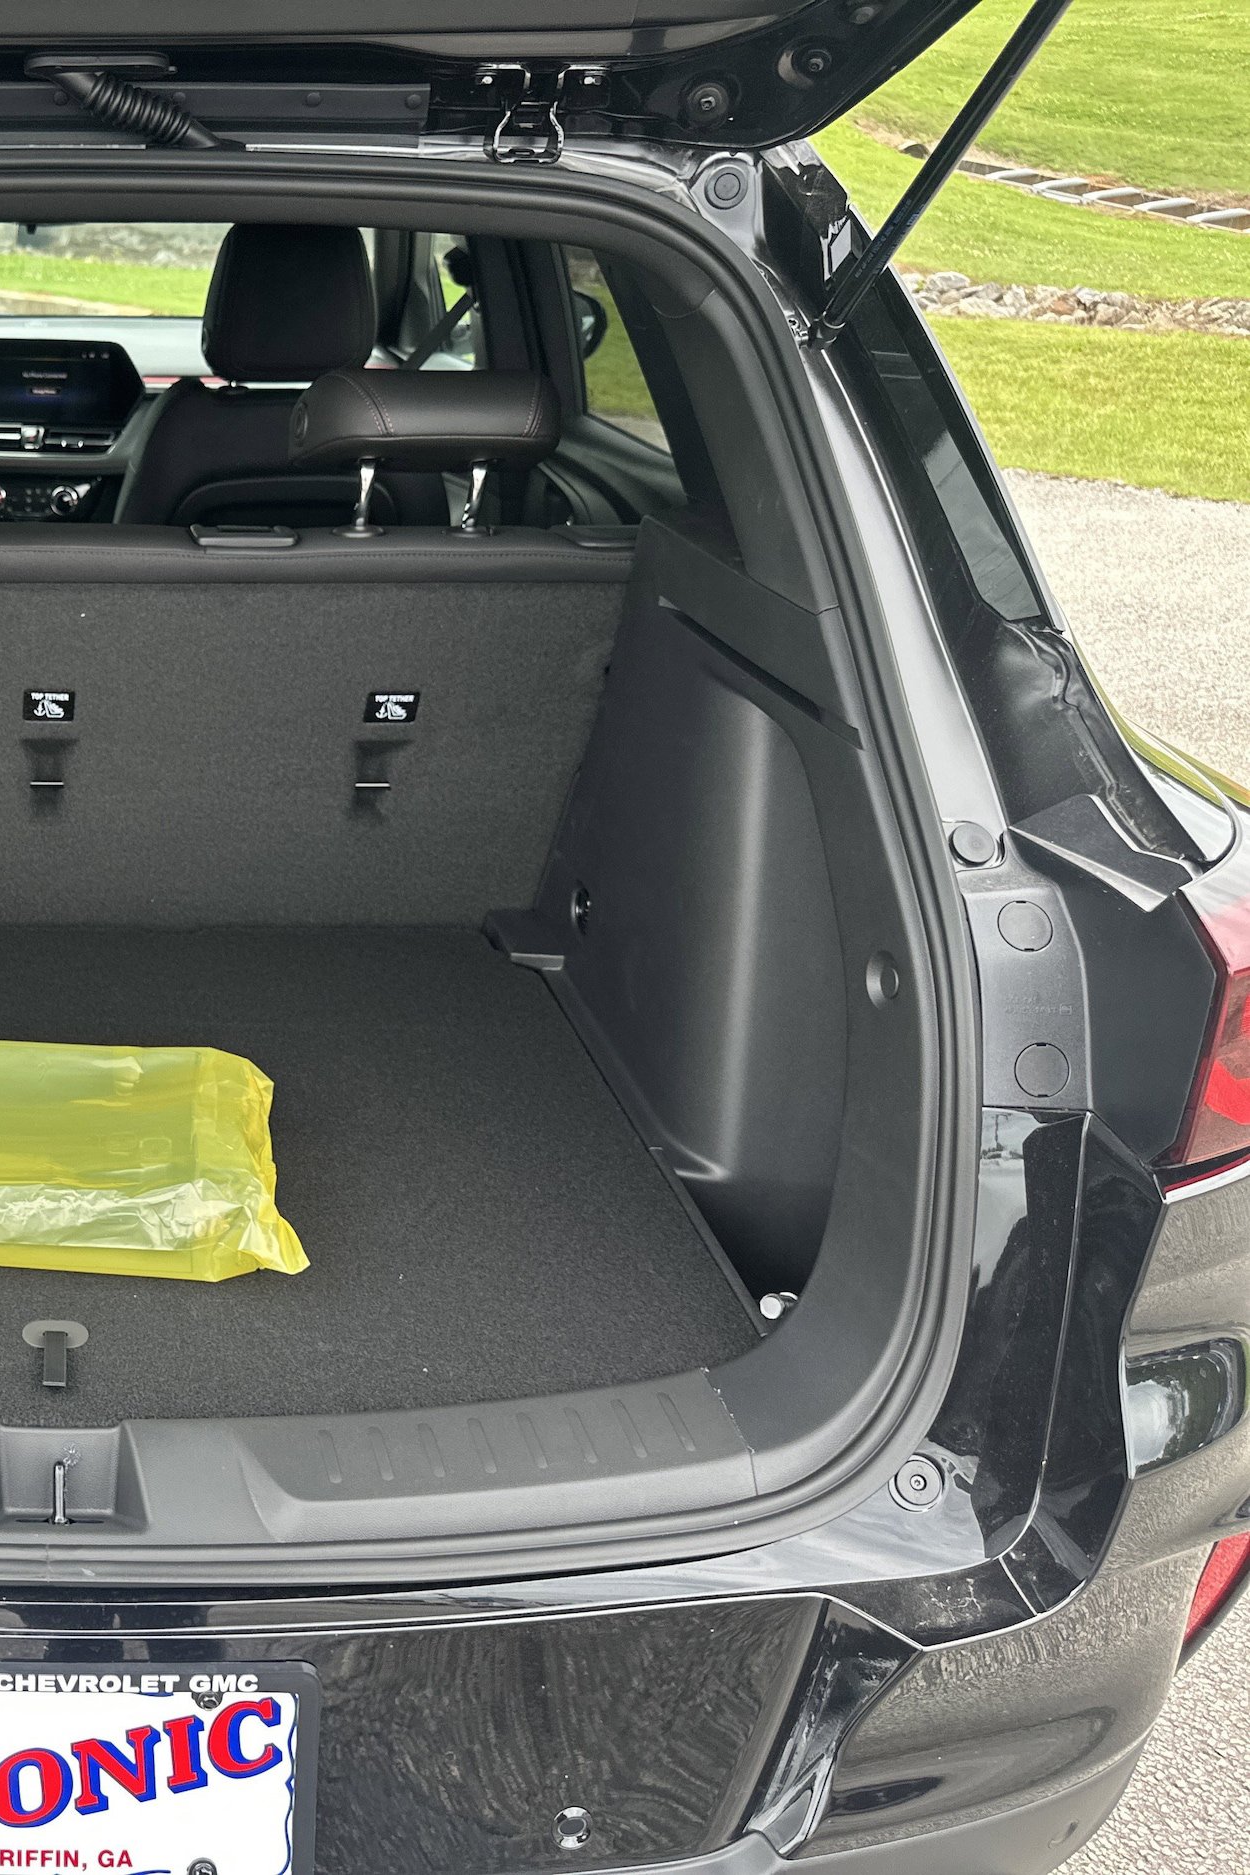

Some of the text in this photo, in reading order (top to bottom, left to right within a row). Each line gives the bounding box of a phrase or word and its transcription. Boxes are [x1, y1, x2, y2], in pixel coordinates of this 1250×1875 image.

[30, 692, 70, 701] TOP TETHER
[374, 694, 415, 702] TOP TETHER
[188, 1674, 259, 1693] GMC
[97, 1849, 133, 1868] GA
